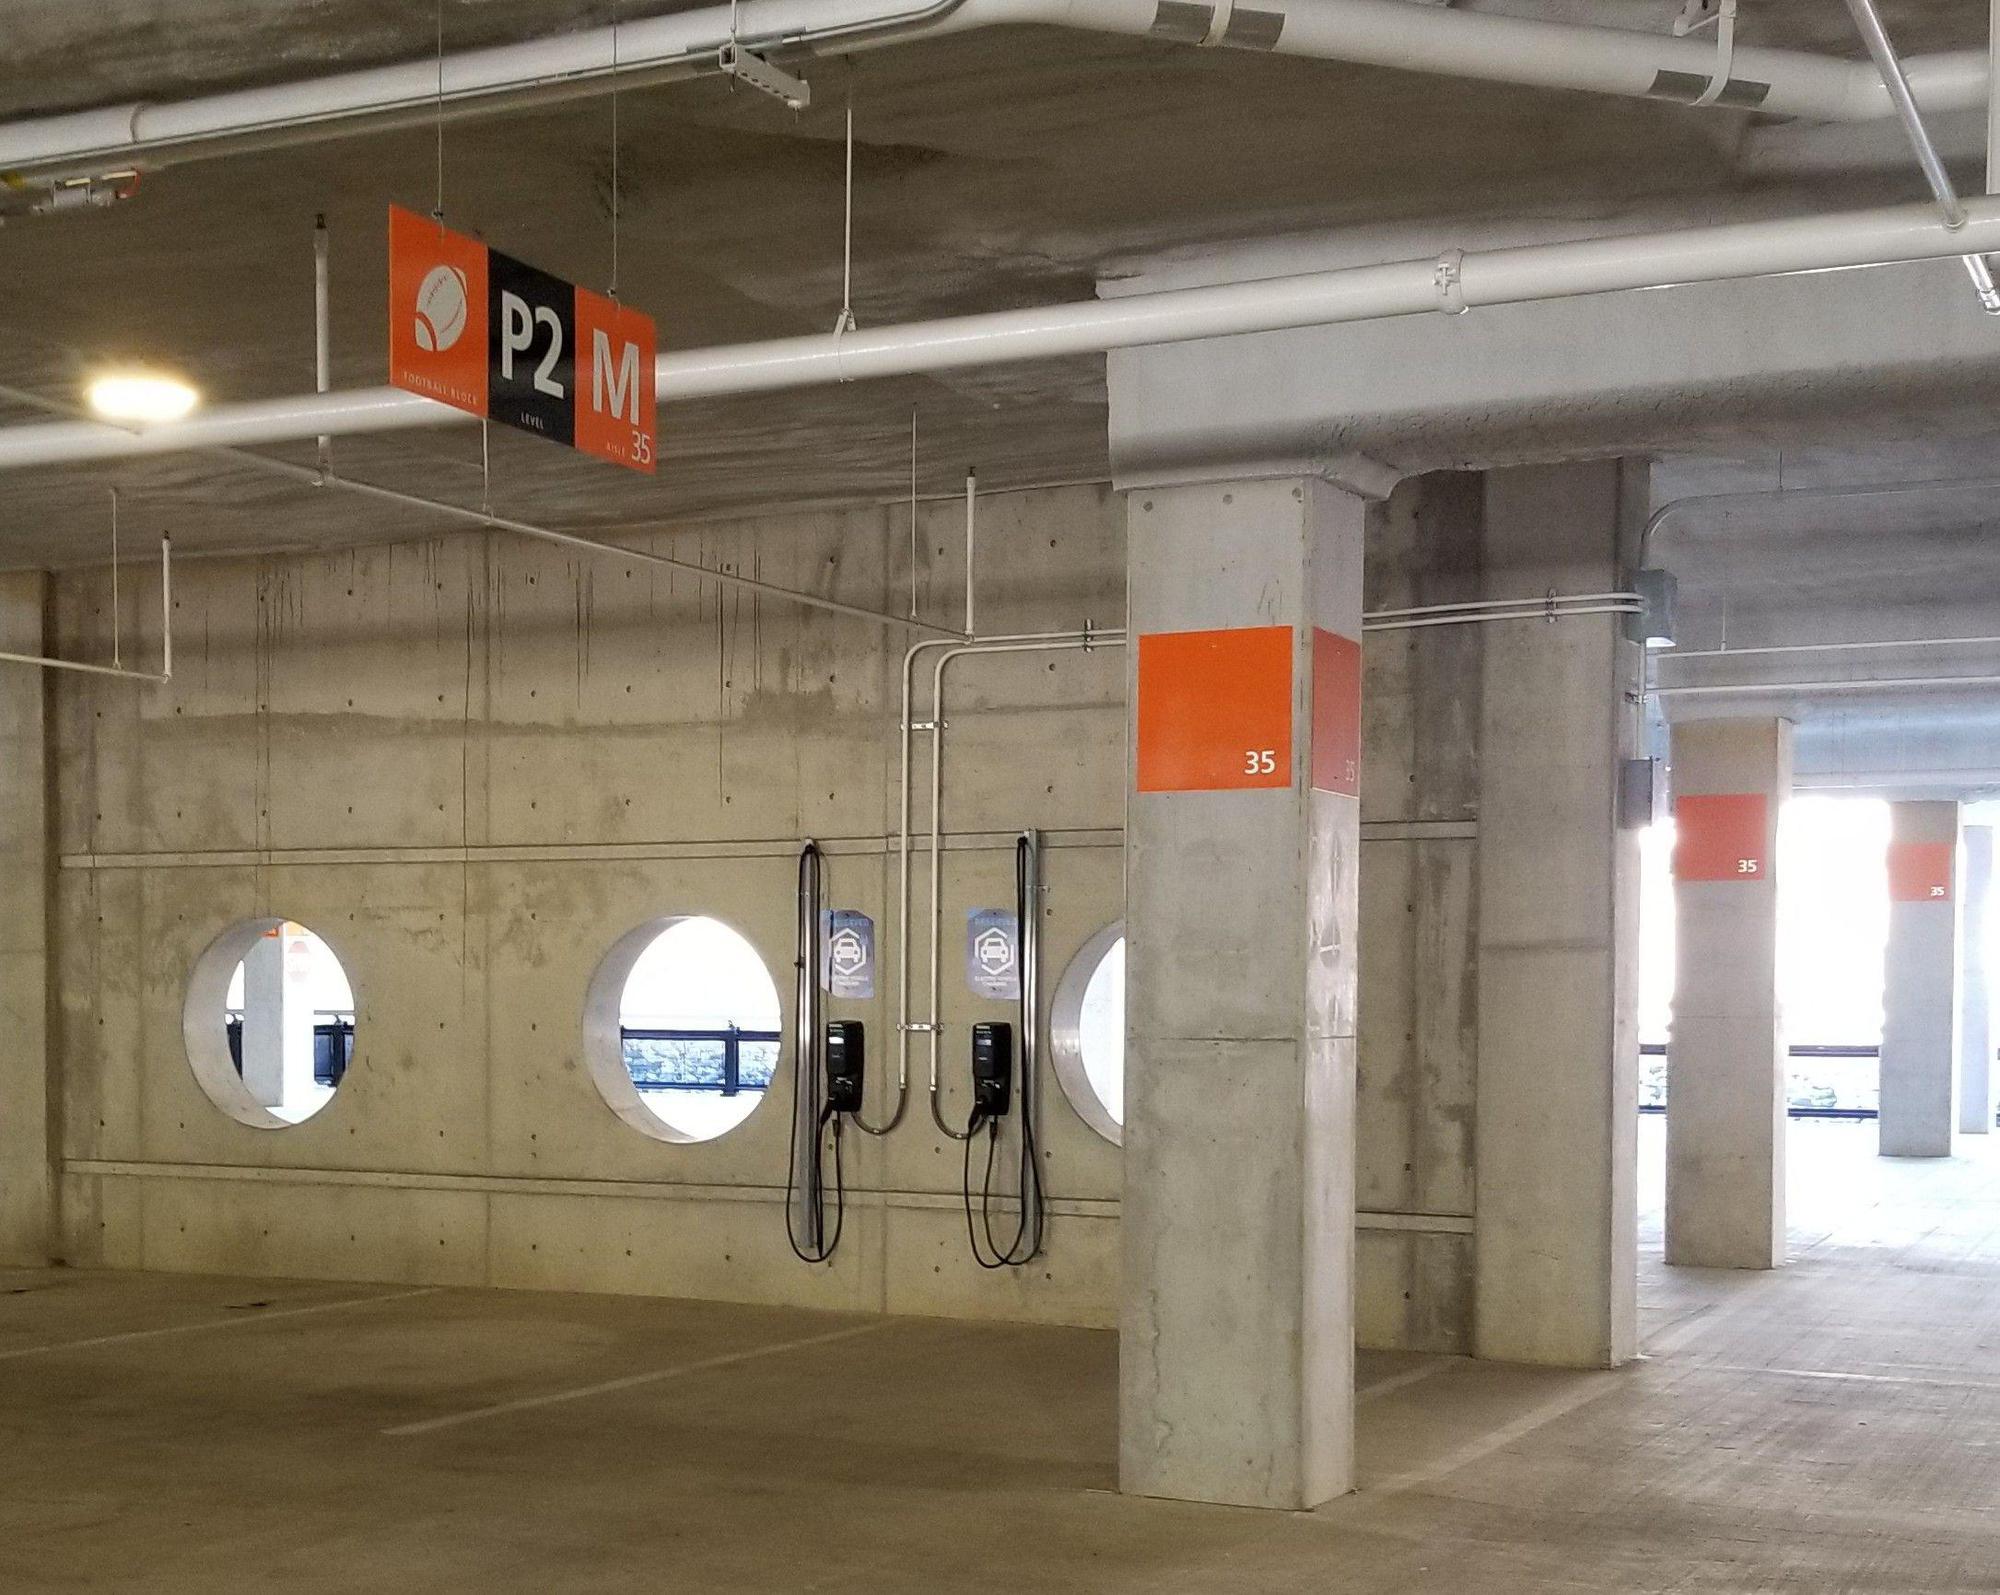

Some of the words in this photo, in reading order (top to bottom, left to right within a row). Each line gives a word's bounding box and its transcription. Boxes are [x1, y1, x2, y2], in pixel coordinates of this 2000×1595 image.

[502, 289, 564, 400] P2
[593, 328, 639, 426] M
[520, 411, 544, 429] LEVEL
[631, 430, 651, 464] 35
[1244, 750, 1275, 774] 35
[1737, 859, 1757, 873] 35
[1930, 886, 1945, 896] 35
